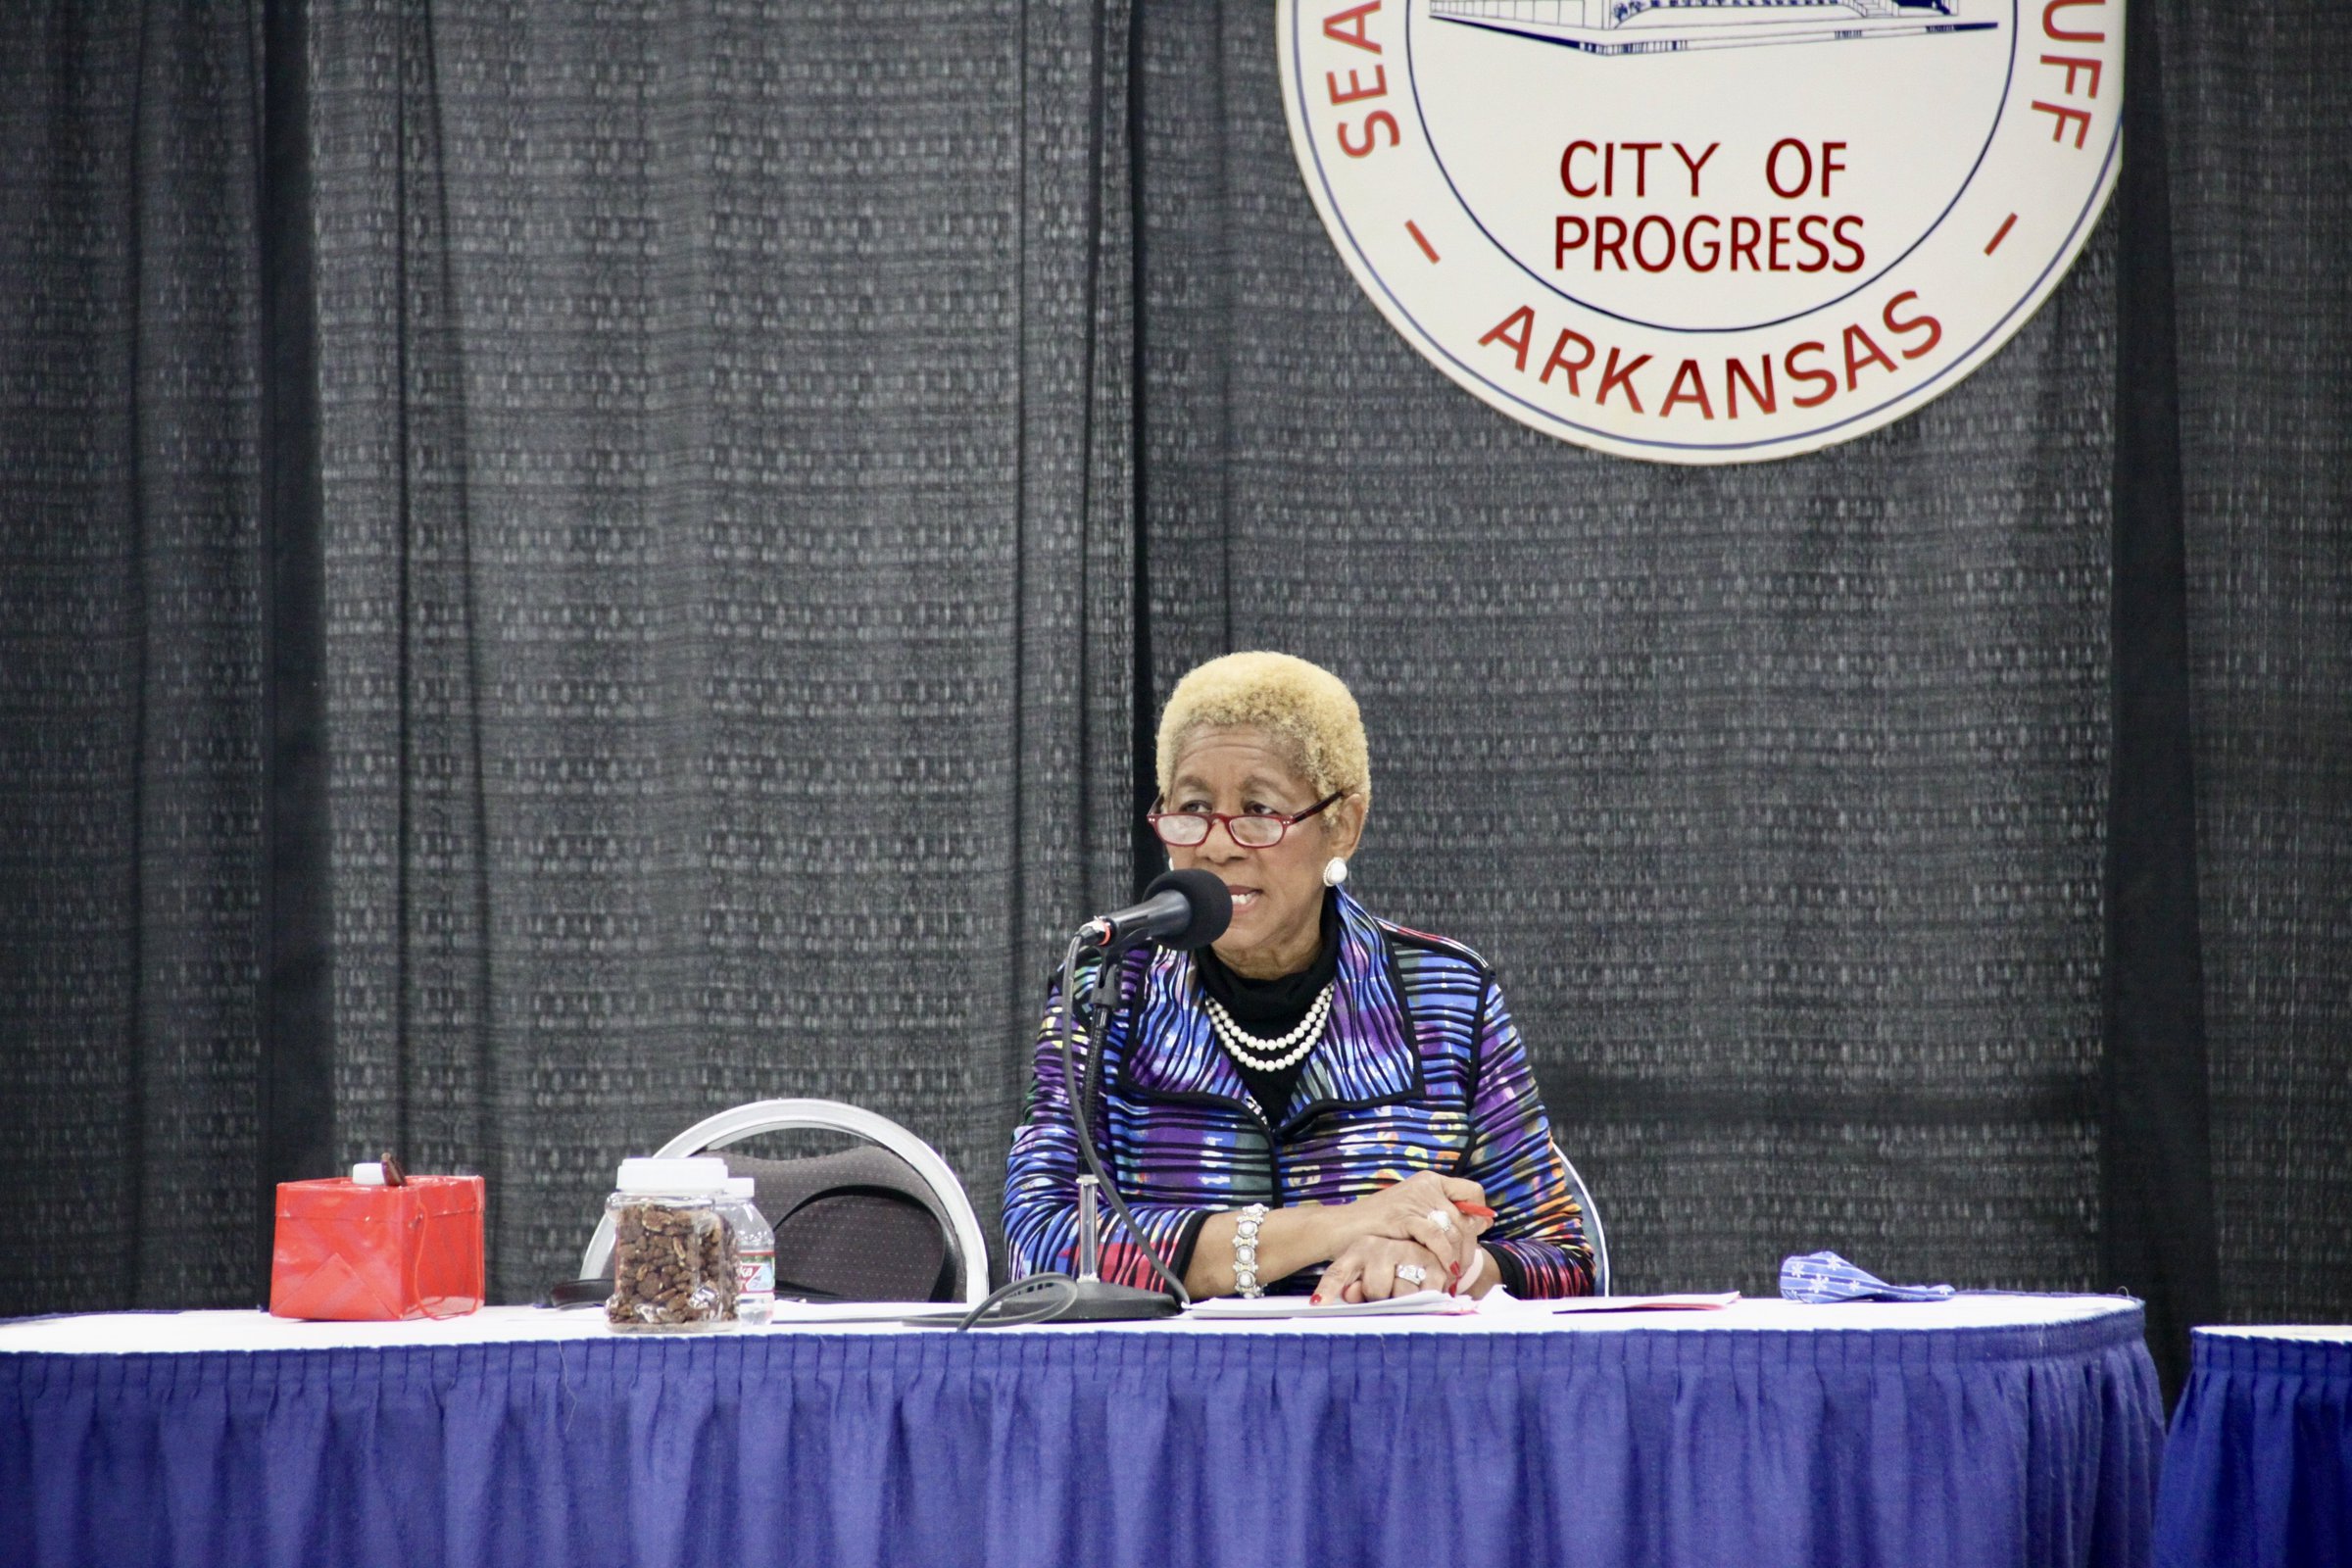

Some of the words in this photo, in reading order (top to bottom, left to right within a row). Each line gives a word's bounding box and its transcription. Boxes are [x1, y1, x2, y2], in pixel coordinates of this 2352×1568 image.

[1559, 140, 1721, 199] CITY
[1765, 137, 1848, 199] OF
[1554, 214, 1867, 274] PROGRESS
[1478, 289, 1943, 421] ARKANSAS
